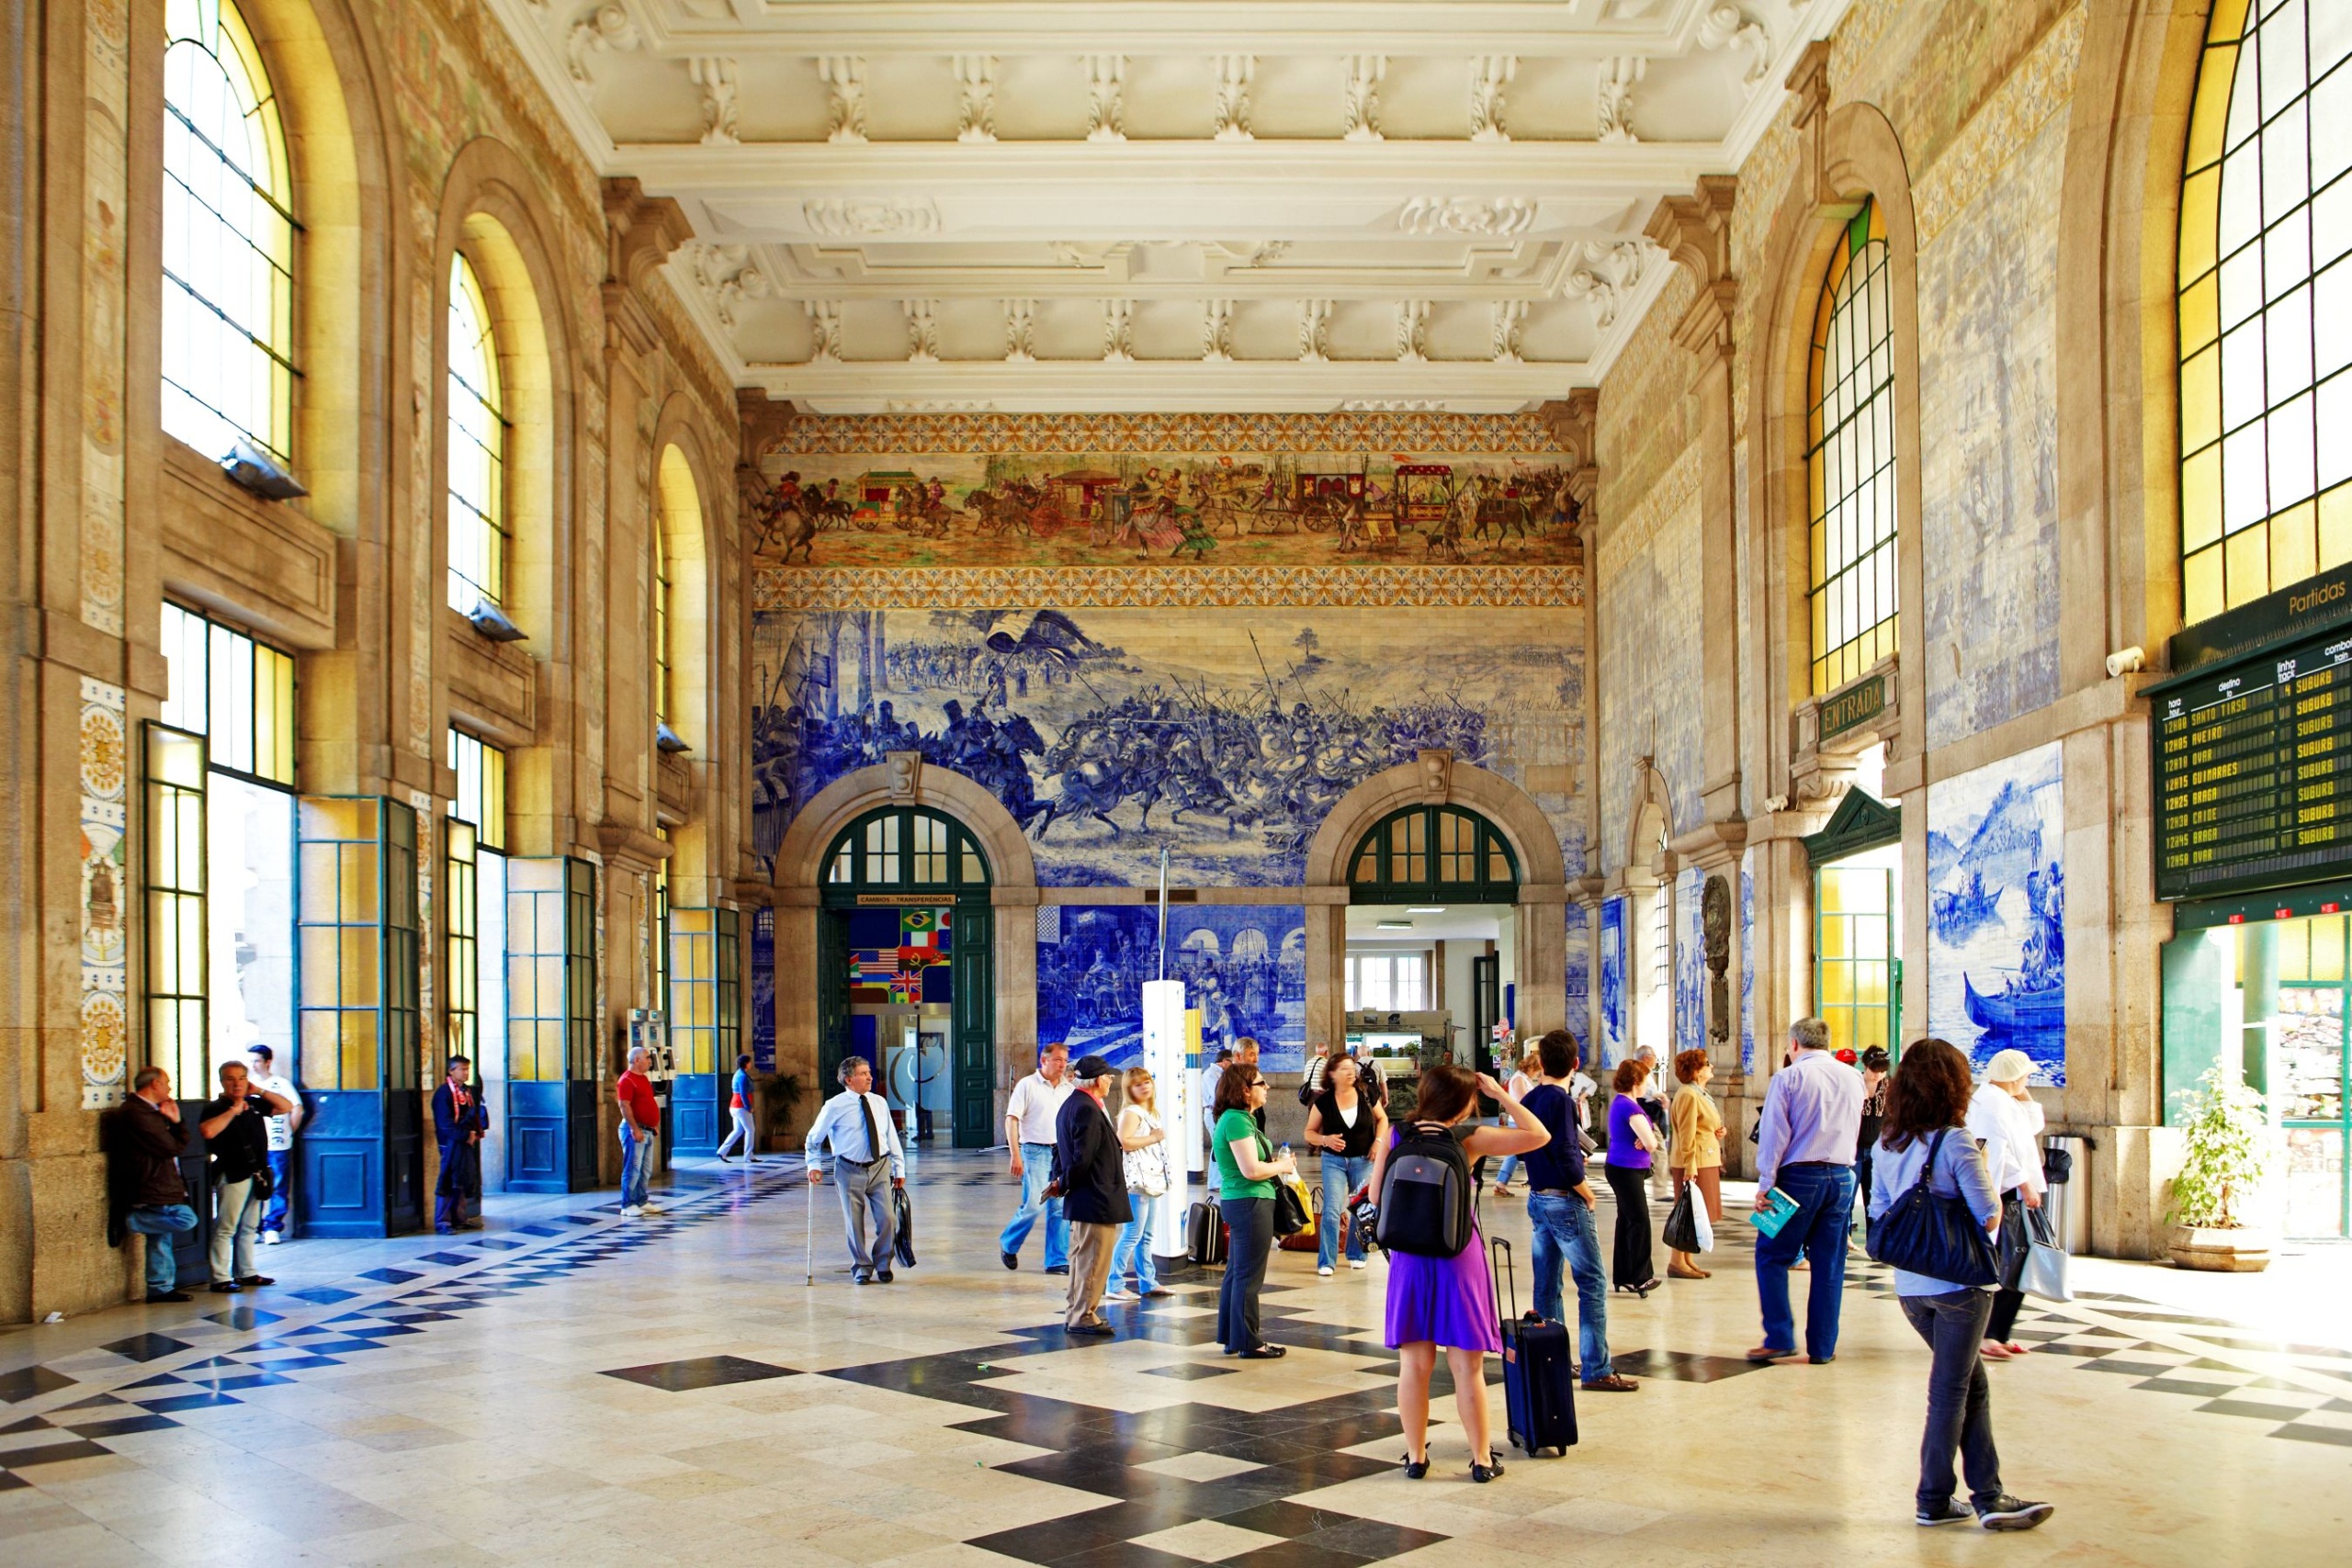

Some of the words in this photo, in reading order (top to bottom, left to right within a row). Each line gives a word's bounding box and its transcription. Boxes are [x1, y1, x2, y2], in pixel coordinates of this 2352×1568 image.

[2289, 581, 2346, 615] Partidas
[2277, 660, 2296, 673] linha
[2278, 670, 2295, 683] track
[2335, 651, 2348, 662] train
[2165, 716, 2187, 735] 12H00
[2191, 707, 2216, 726] SANTO
[2222, 697, 2246, 716] TIRSO
[2284, 683, 2290, 696] 4
[2296, 670, 2332, 694] SUBURB
[2168, 698, 2181, 708] hora
[2218, 678, 2241, 692] destino
[1825, 682, 1881, 732] ENTRADA
[2165, 736, 2188, 753] 12H05
[2192, 726, 2222, 746] AVEIRO
[2297, 692, 2332, 716] SUBURB
[2169, 708, 2180, 716] hour
[2165, 755, 2188, 773] 12H10
[2192, 749, 2212, 765] OVAR
[2297, 714, 2333, 737] SUBURB
[2165, 774, 2188, 792] 12H15
[2192, 761, 2237, 785] GUIMARAES
[2297, 737, 2333, 759] SUBURB
[2165, 794, 2188, 811] 12H25
[2192, 787, 2217, 805] BRAGA
[2298, 759, 2333, 780] SUBURB
[2165, 814, 2188, 830] 12H30
[2192, 807, 2217, 825] CAIDE
[2298, 781, 2334, 802] SUBURB
[2193, 828, 2217, 844] BRAGA
[2299, 803, 2334, 824] SUBURB
[2166, 852, 2188, 869] 12H50
[2193, 848, 2212, 863] OVAR
[2299, 826, 2334, 845] SUBURB
